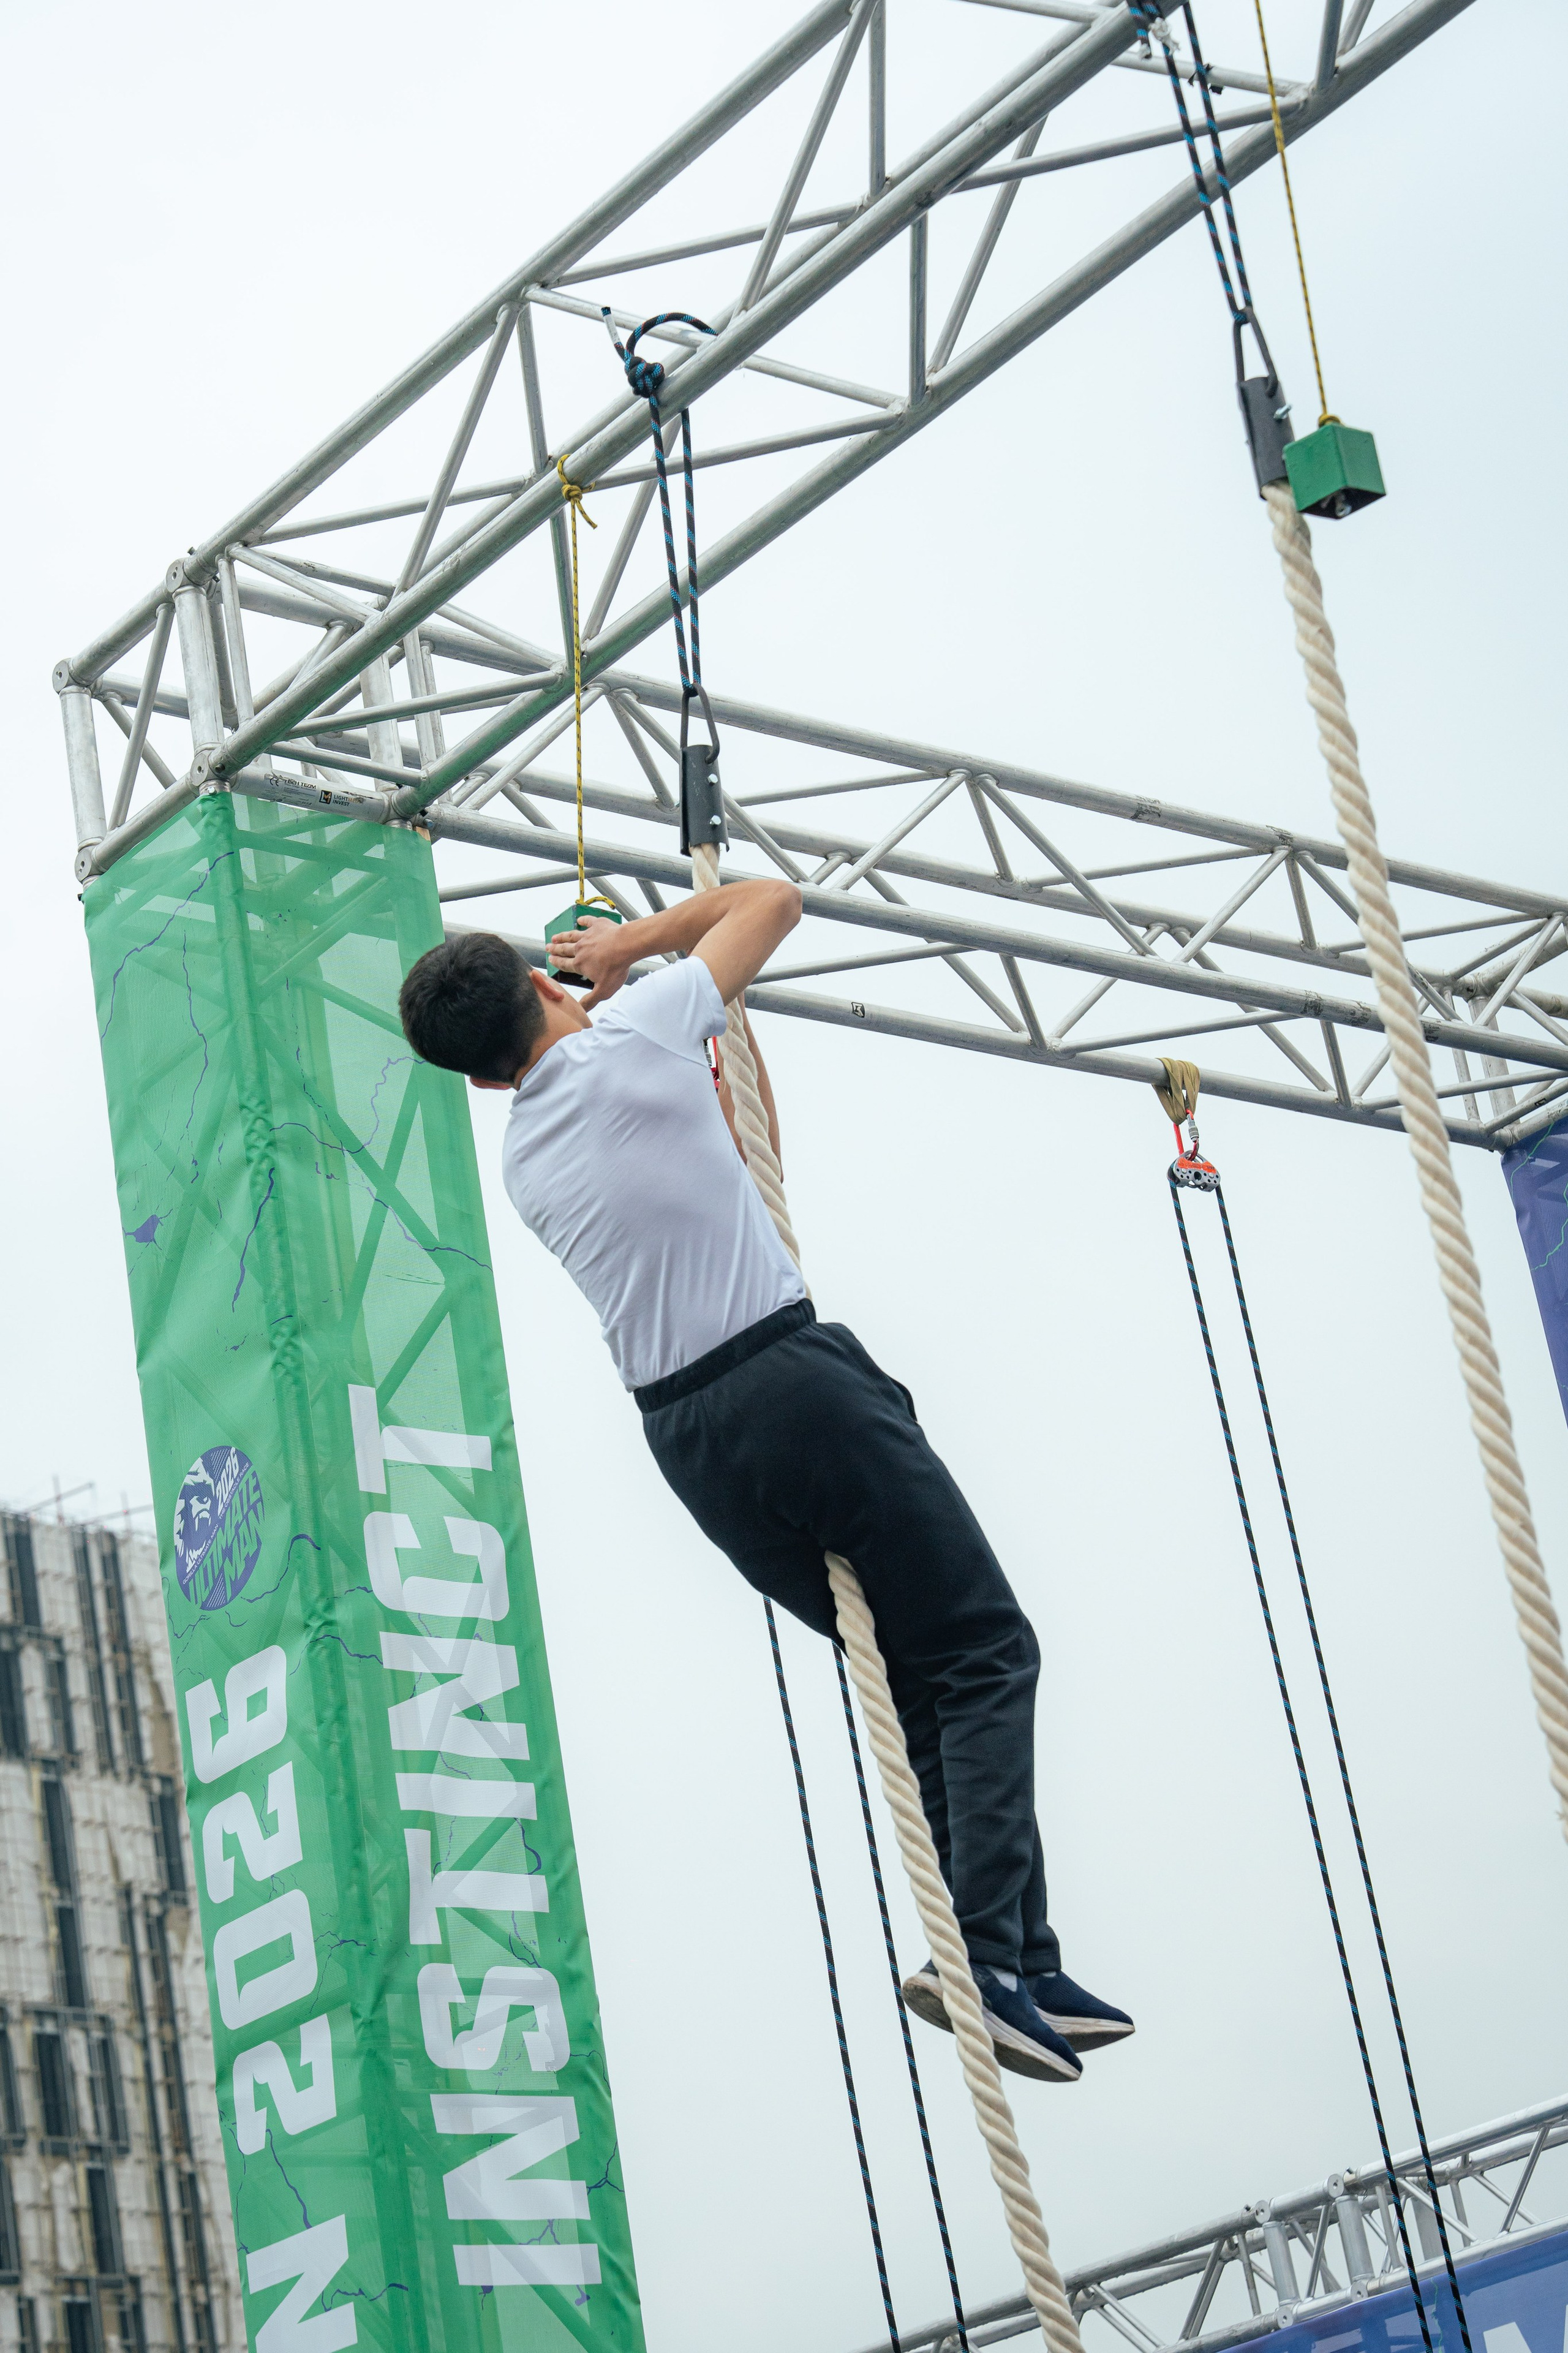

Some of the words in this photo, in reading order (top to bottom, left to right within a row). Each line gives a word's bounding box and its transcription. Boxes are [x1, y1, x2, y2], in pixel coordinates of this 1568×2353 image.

[183, 1564, 198, 1585] GORILLA
[197, 1539, 212, 1565] ULTIMATE
[224, 1476, 241, 1508] OBSTACLE
[239, 1462, 249, 1478] RACE
[189, 1468, 262, 1609] ULTIMATE
[216, 1447, 239, 1517] 2026
[223, 1501, 265, 1603] MAN
[186, 1645, 338, 2156] 2026
[349, 1384, 602, 2287] INSTINCT
